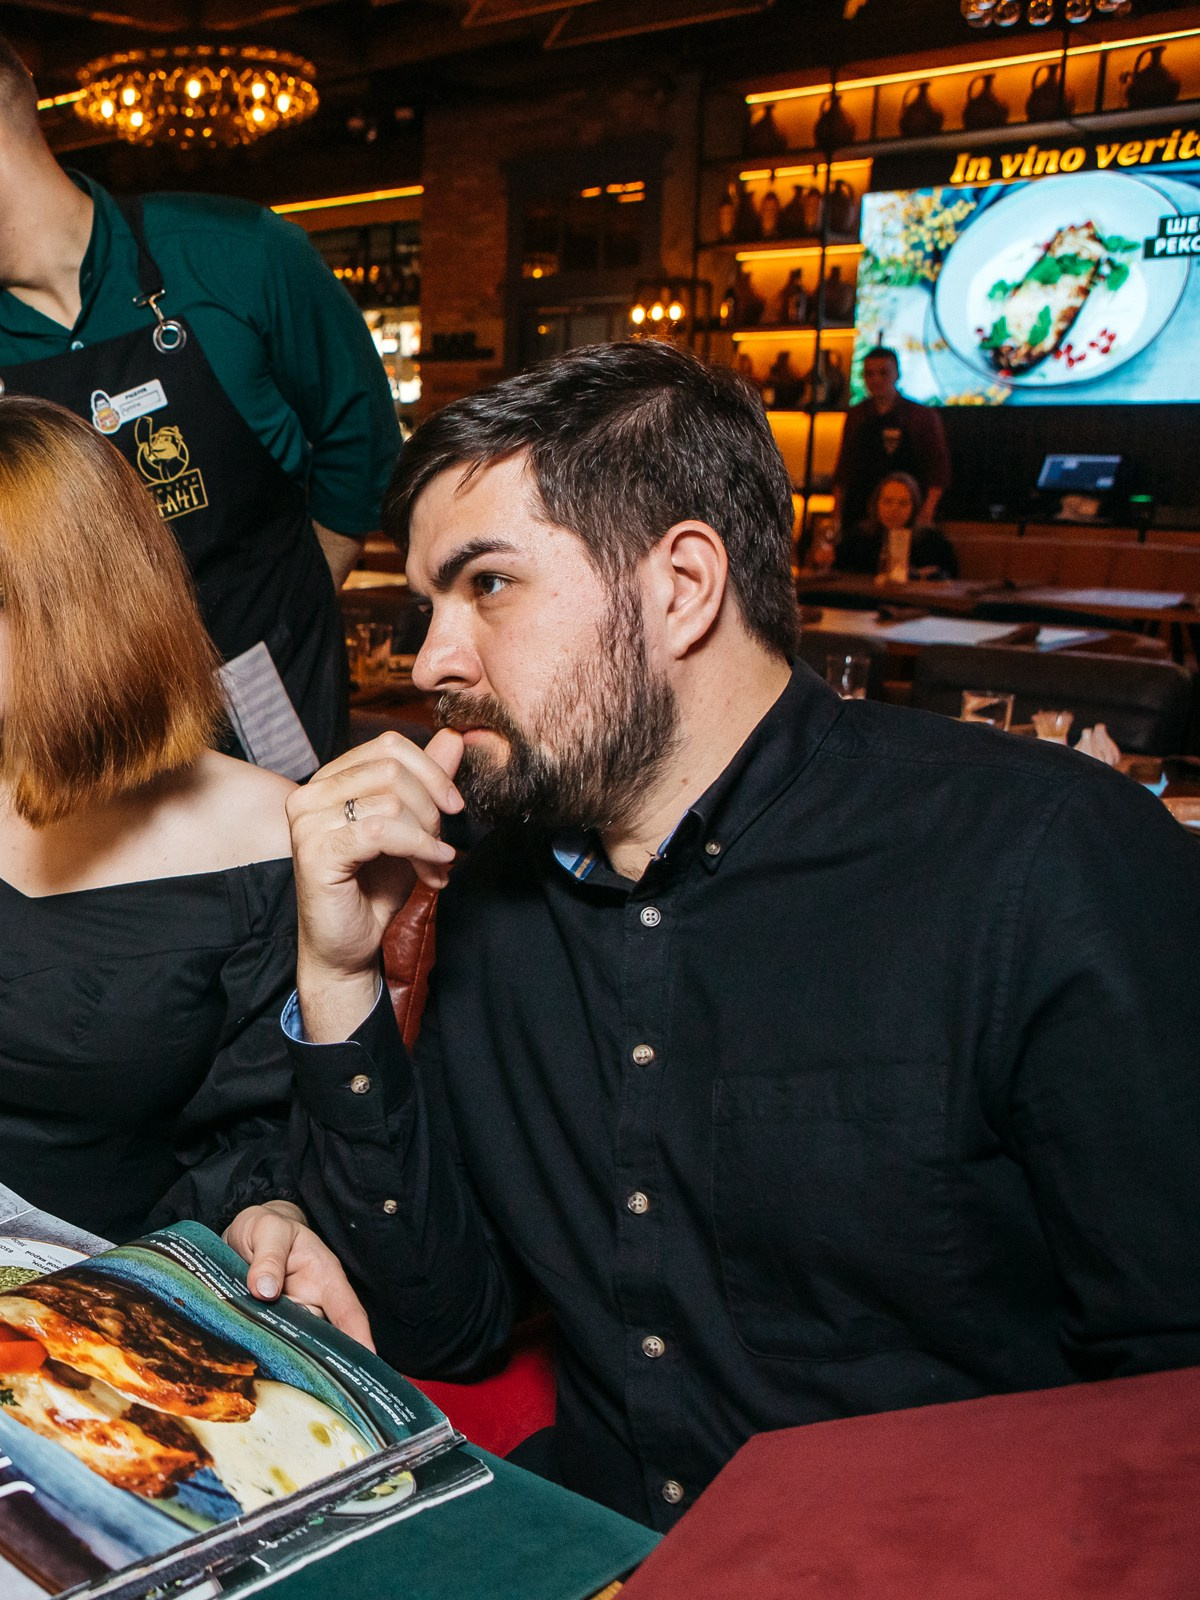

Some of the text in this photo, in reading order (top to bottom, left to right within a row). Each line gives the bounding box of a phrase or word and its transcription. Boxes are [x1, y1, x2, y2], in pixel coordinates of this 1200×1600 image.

[950, 152, 992, 183] In
[1000, 144, 1086, 179] vino
[1165, 216, 1200, 235] ШЕ
[195, 1271, 227, 1300] Лазанья
[206, 1273, 234, 1298] соусом
[325, 1355, 363, 1386] грибами
[368, 1391, 405, 1426] Лазанья
